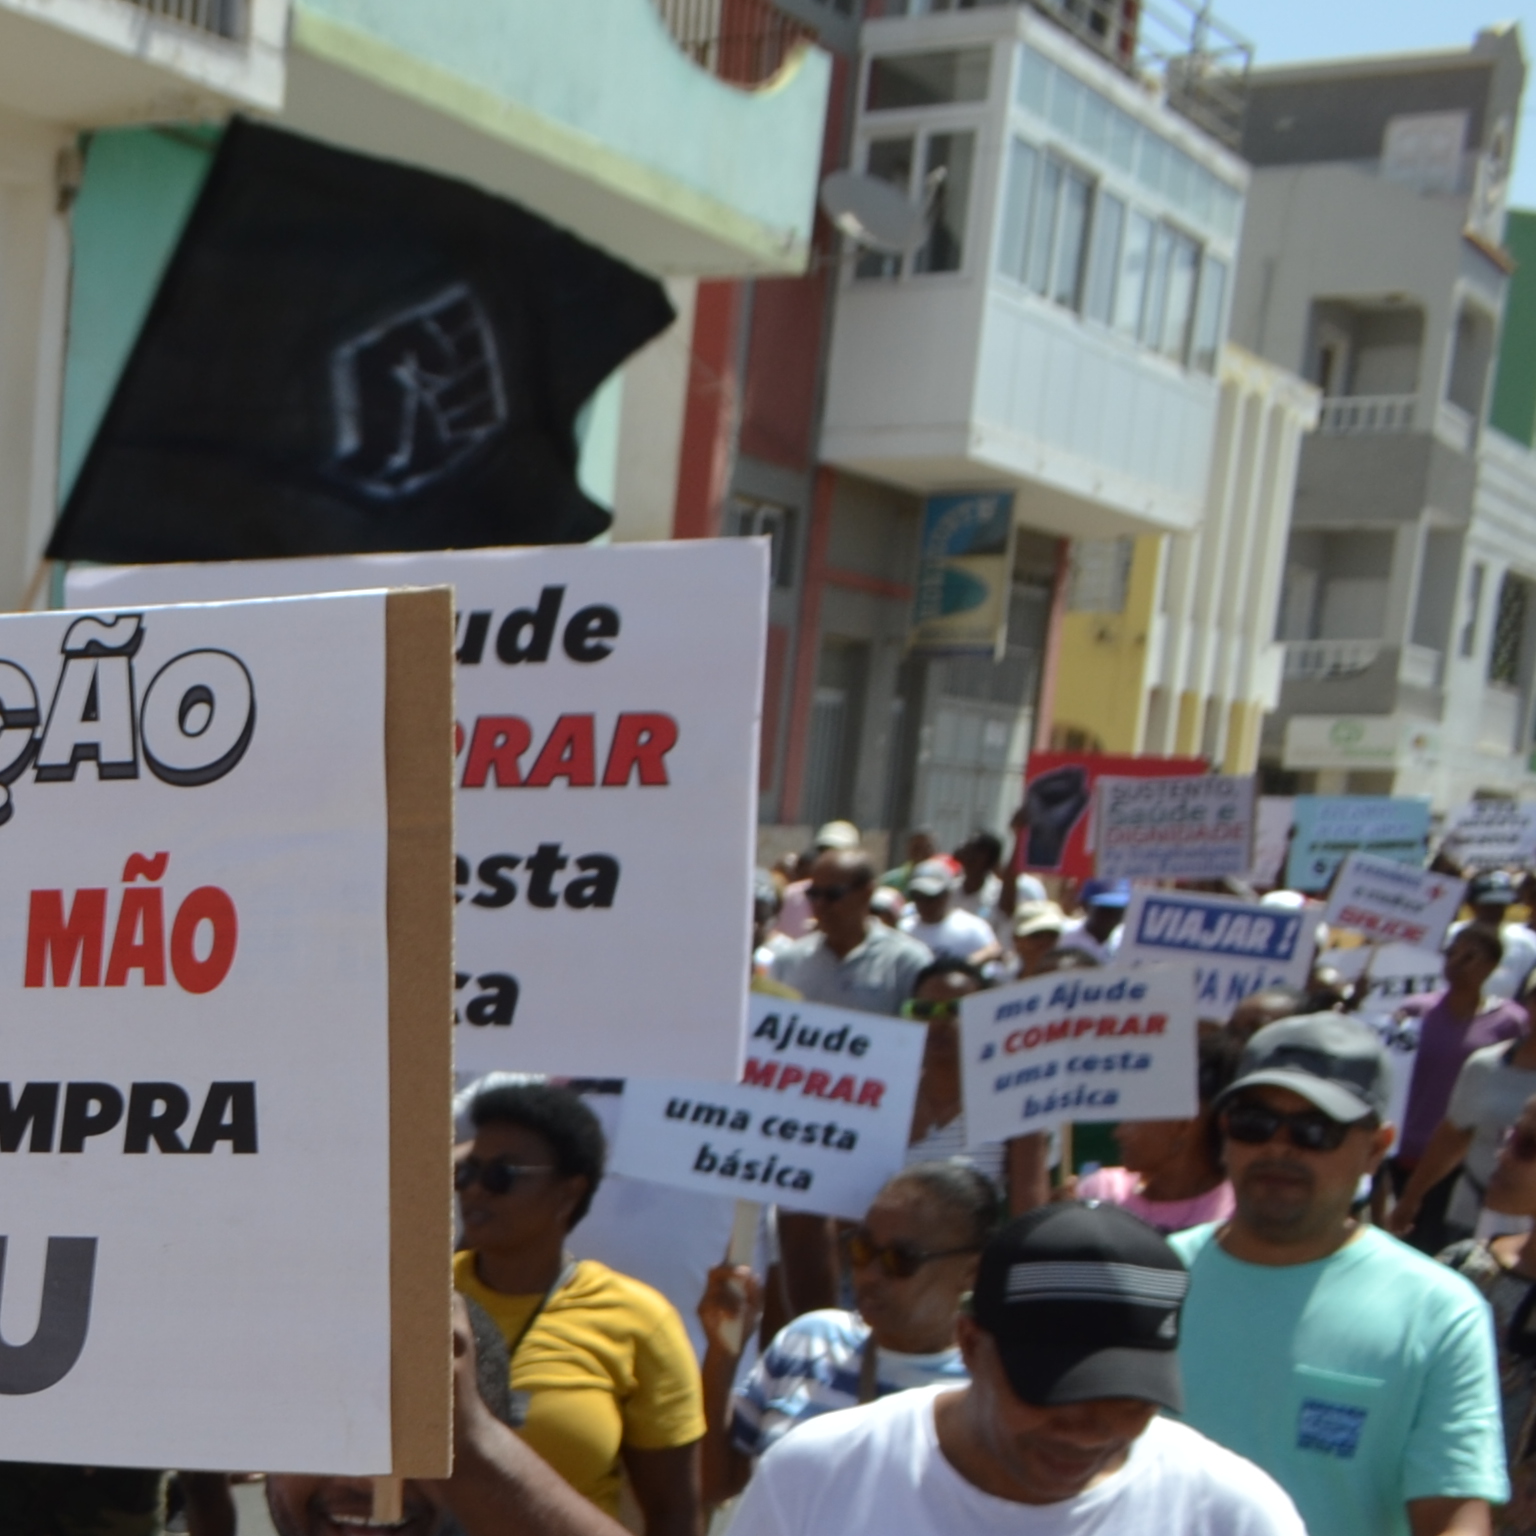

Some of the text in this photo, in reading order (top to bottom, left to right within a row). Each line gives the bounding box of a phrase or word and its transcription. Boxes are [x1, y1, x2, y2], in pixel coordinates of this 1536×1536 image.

[454, 584, 621, 665] ude
[455, 712, 679, 788] RAR
[455, 843, 620, 909] sta
[24, 852, 238, 995] MÃO
[1145, 905, 1274, 951] VIAJAR
[995, 980, 1147, 1022] me Ajude
[753, 1012, 870, 1056] Ajude
[981, 1014, 1168, 1061] a COMPRAR
[741, 1057, 886, 1108] MPRAR
[995, 1052, 1151, 1093] uma cesta
[665, 1098, 856, 1152] uma cesta
[1023, 1085, 1120, 1118] básica
[693, 1142, 812, 1191] básica
